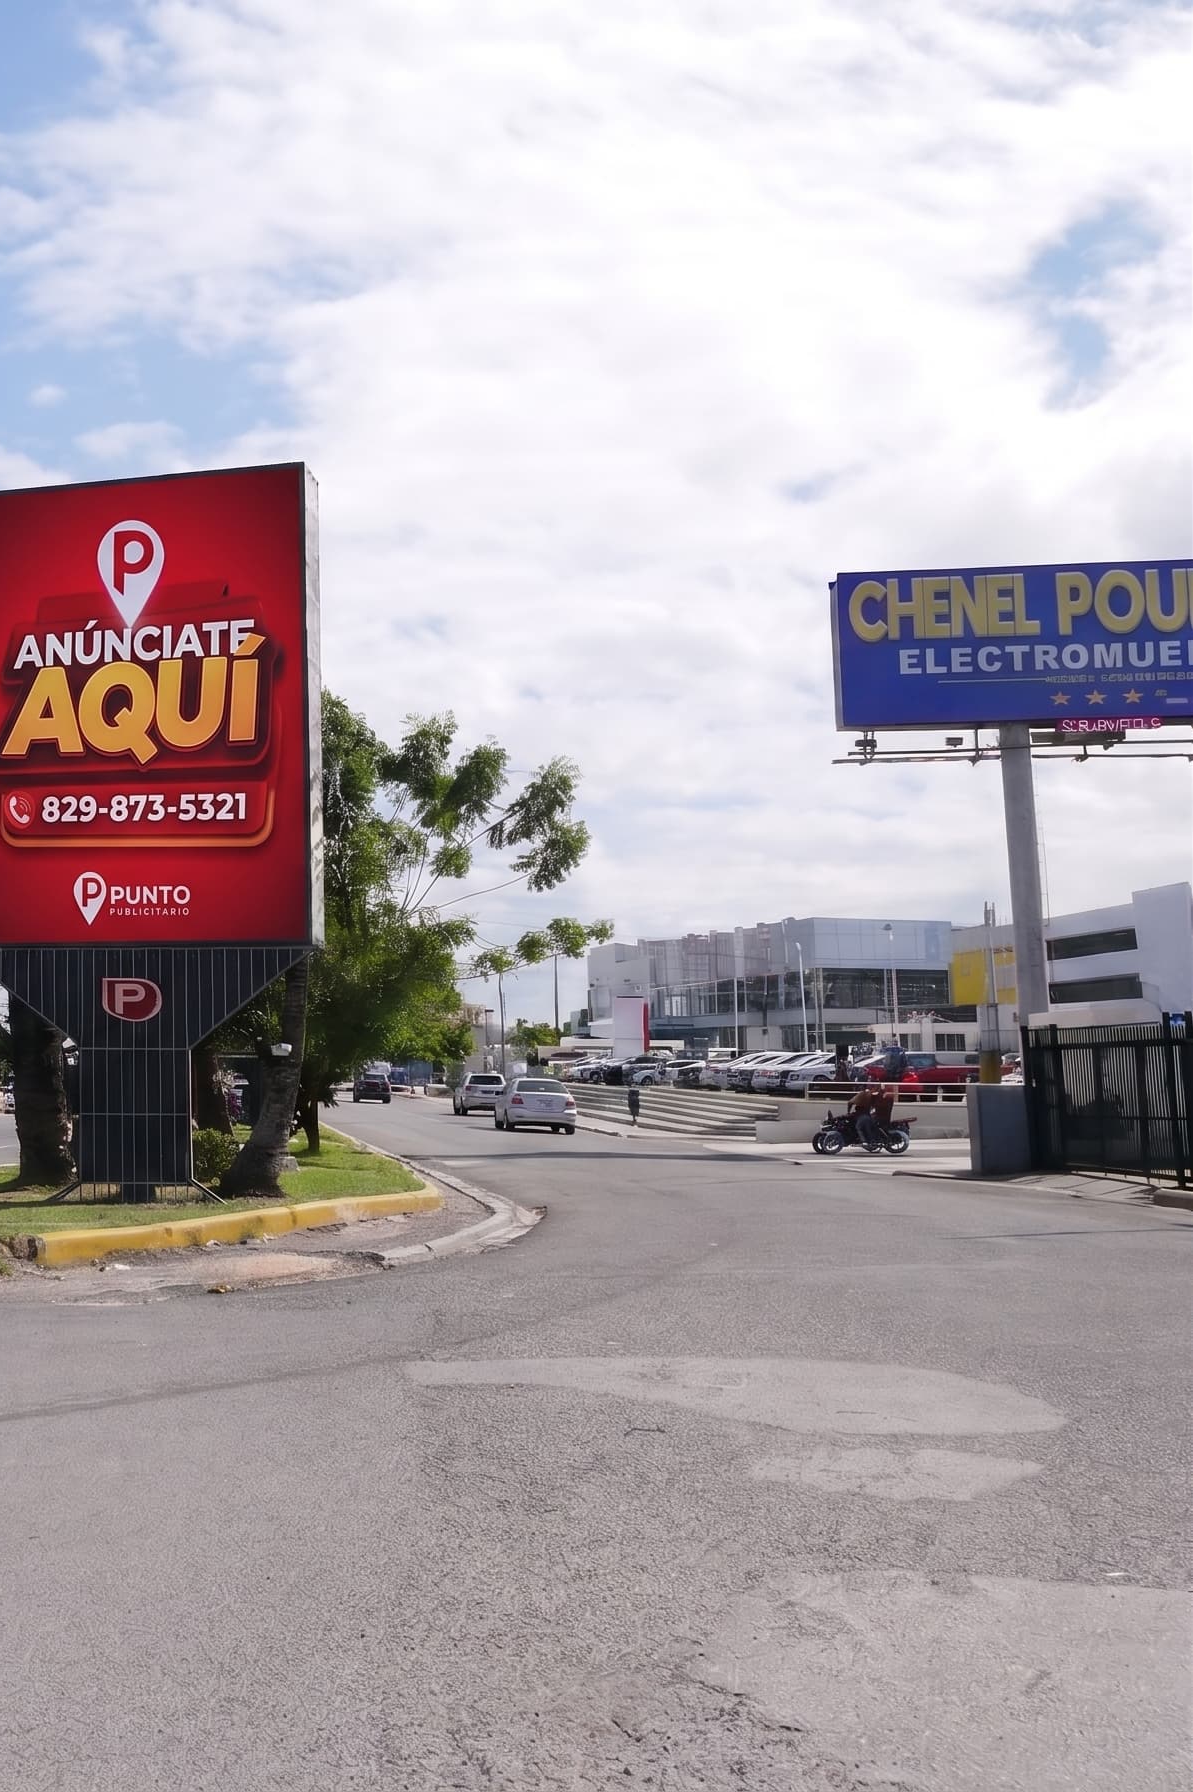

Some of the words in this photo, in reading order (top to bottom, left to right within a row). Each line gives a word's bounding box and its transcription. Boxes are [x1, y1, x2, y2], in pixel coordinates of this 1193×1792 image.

[848, 573, 1041, 643] CHENEL
[1055, 567, 1193, 636] POU
[13, 619, 255, 669] ANÚNCIATE
[1, 632, 266, 765] AQUÍ
[41, 793, 247, 822] 829-873-5321
[109, 907, 190, 917] PUBLICITARIO
[110, 885, 191, 905] PUNTO
